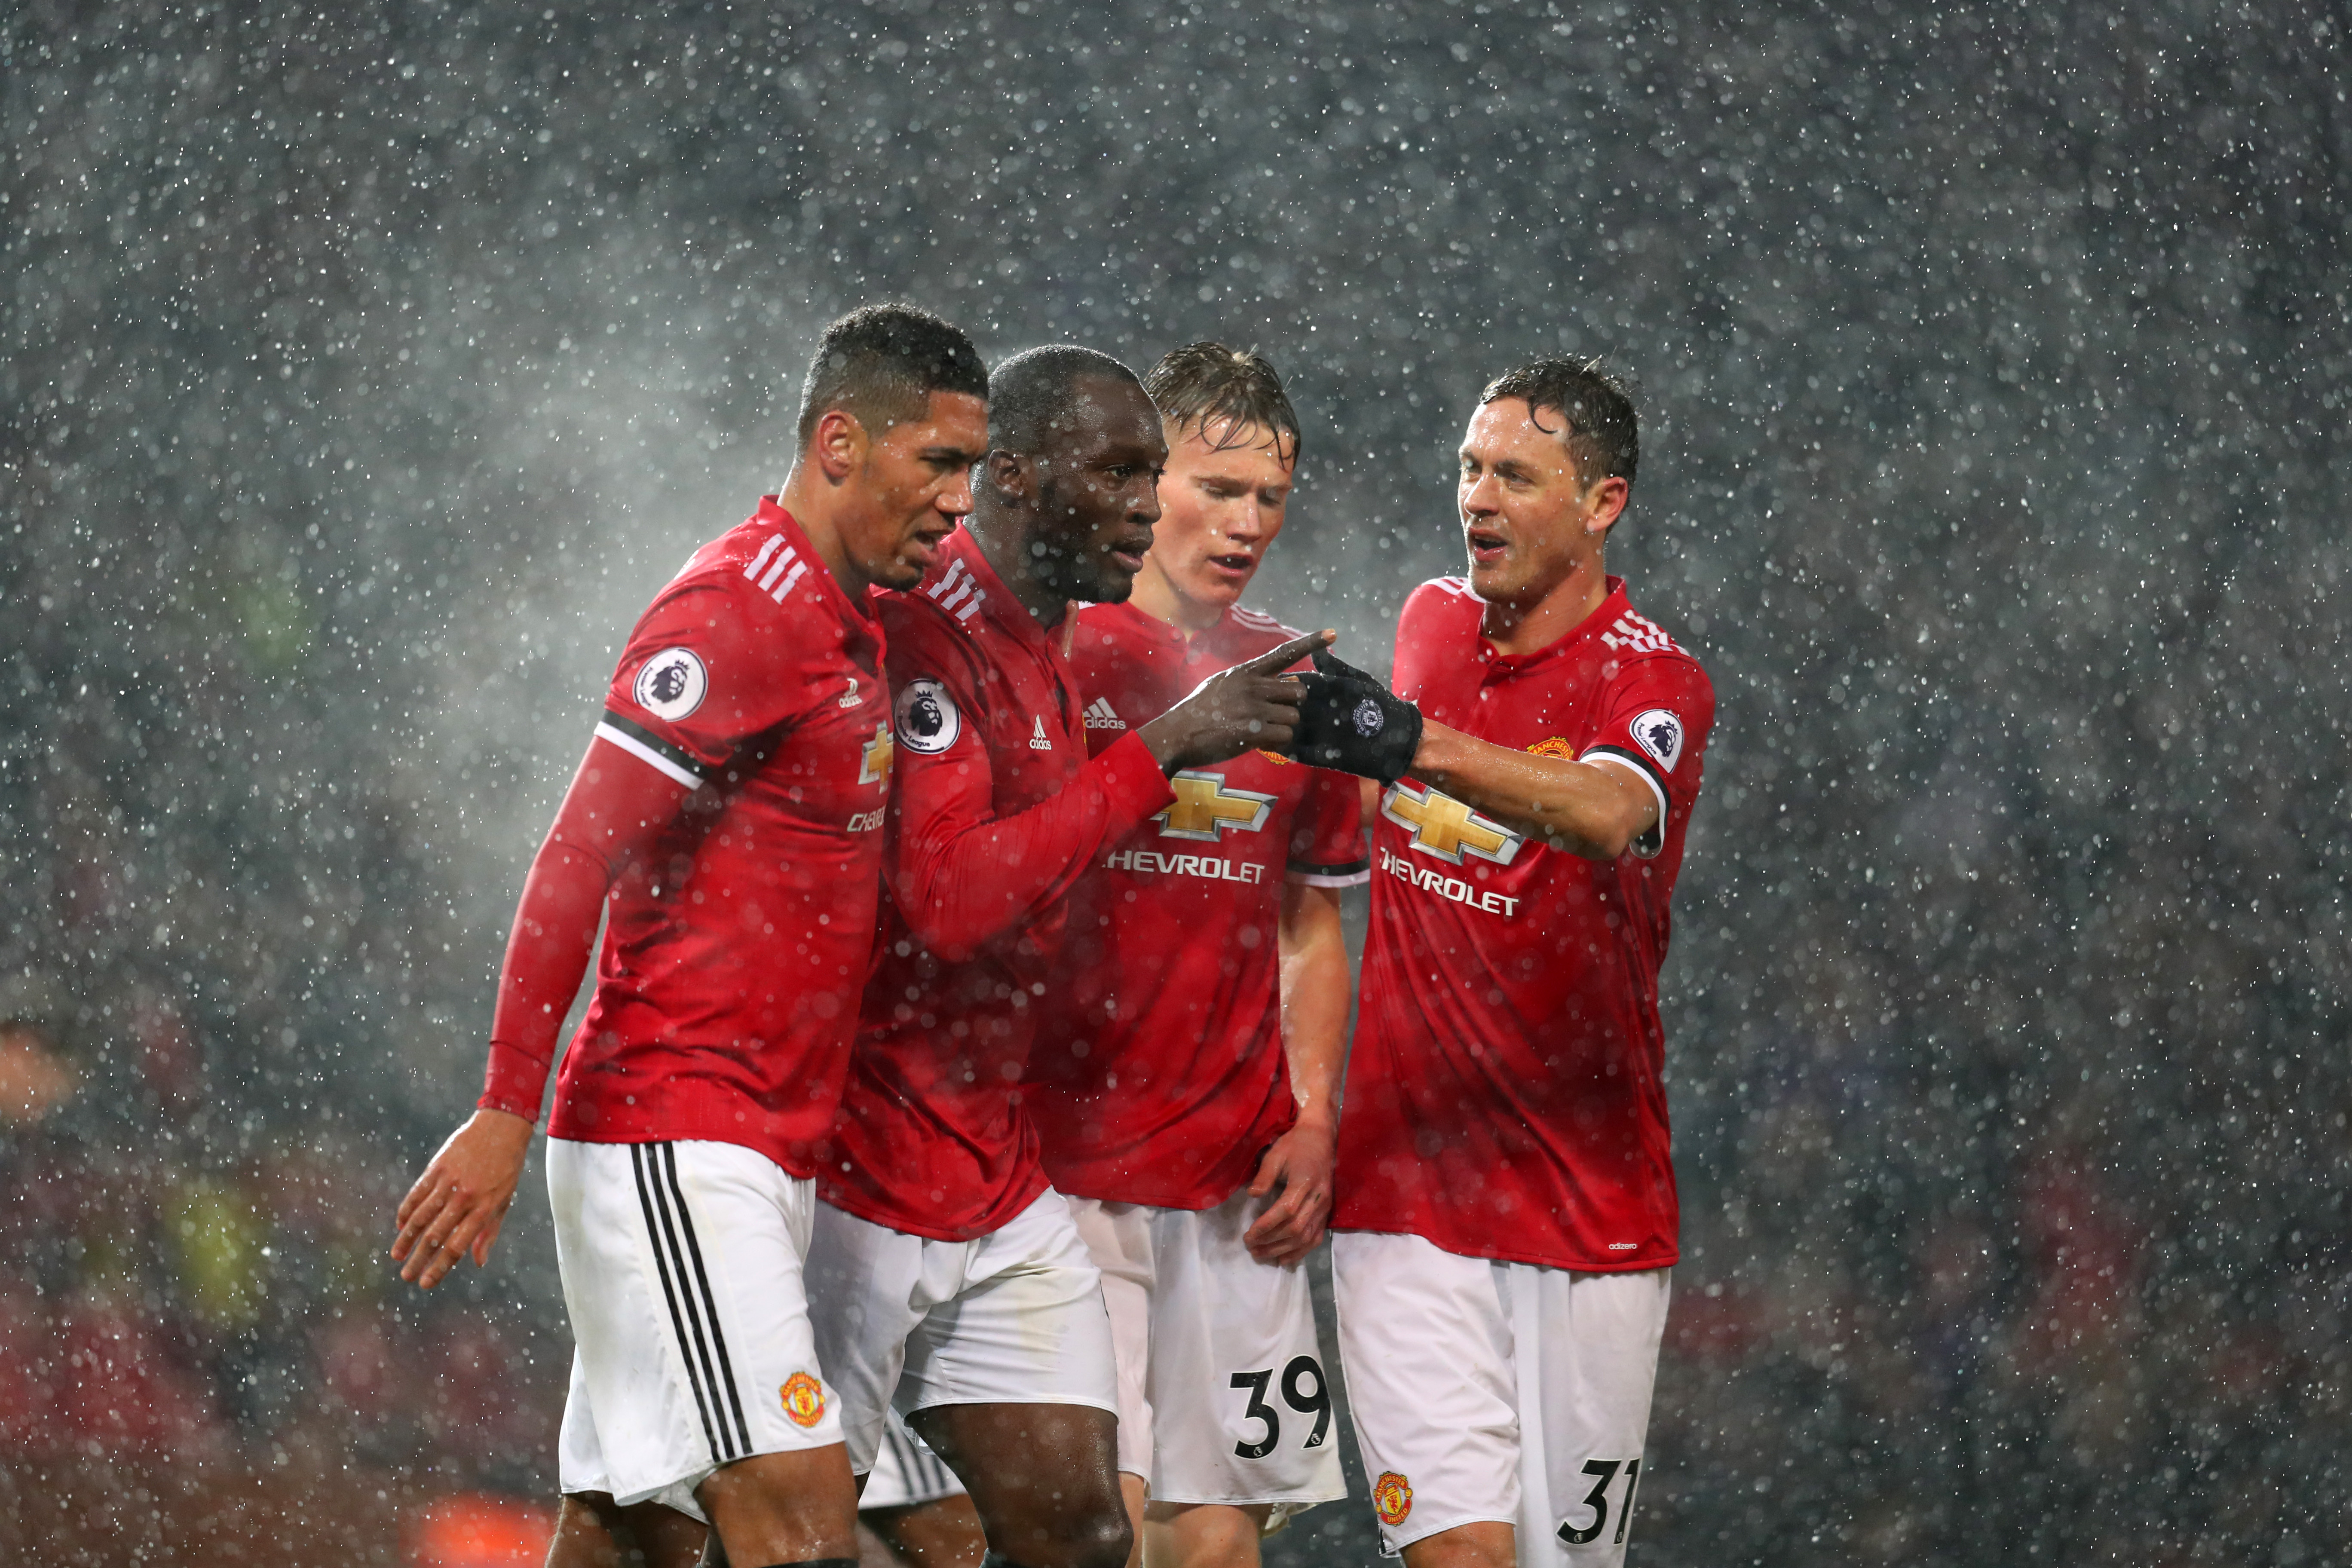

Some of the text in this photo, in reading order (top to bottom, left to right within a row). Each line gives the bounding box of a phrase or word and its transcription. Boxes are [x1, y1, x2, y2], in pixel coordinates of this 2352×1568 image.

[1085, 717, 1127, 729] didas
[908, 735, 930, 747] League
[1029, 737, 1052, 750] adidas
[1641, 737, 1657, 754] League
[1102, 850, 1265, 884] HEVROLET
[1228, 1354, 1331, 1460] 39
[1376, 1475, 1406, 1499] MANCHESTER
[1554, 1457, 1641, 1546] 31
[1387, 1508, 1408, 1522] UNITED
